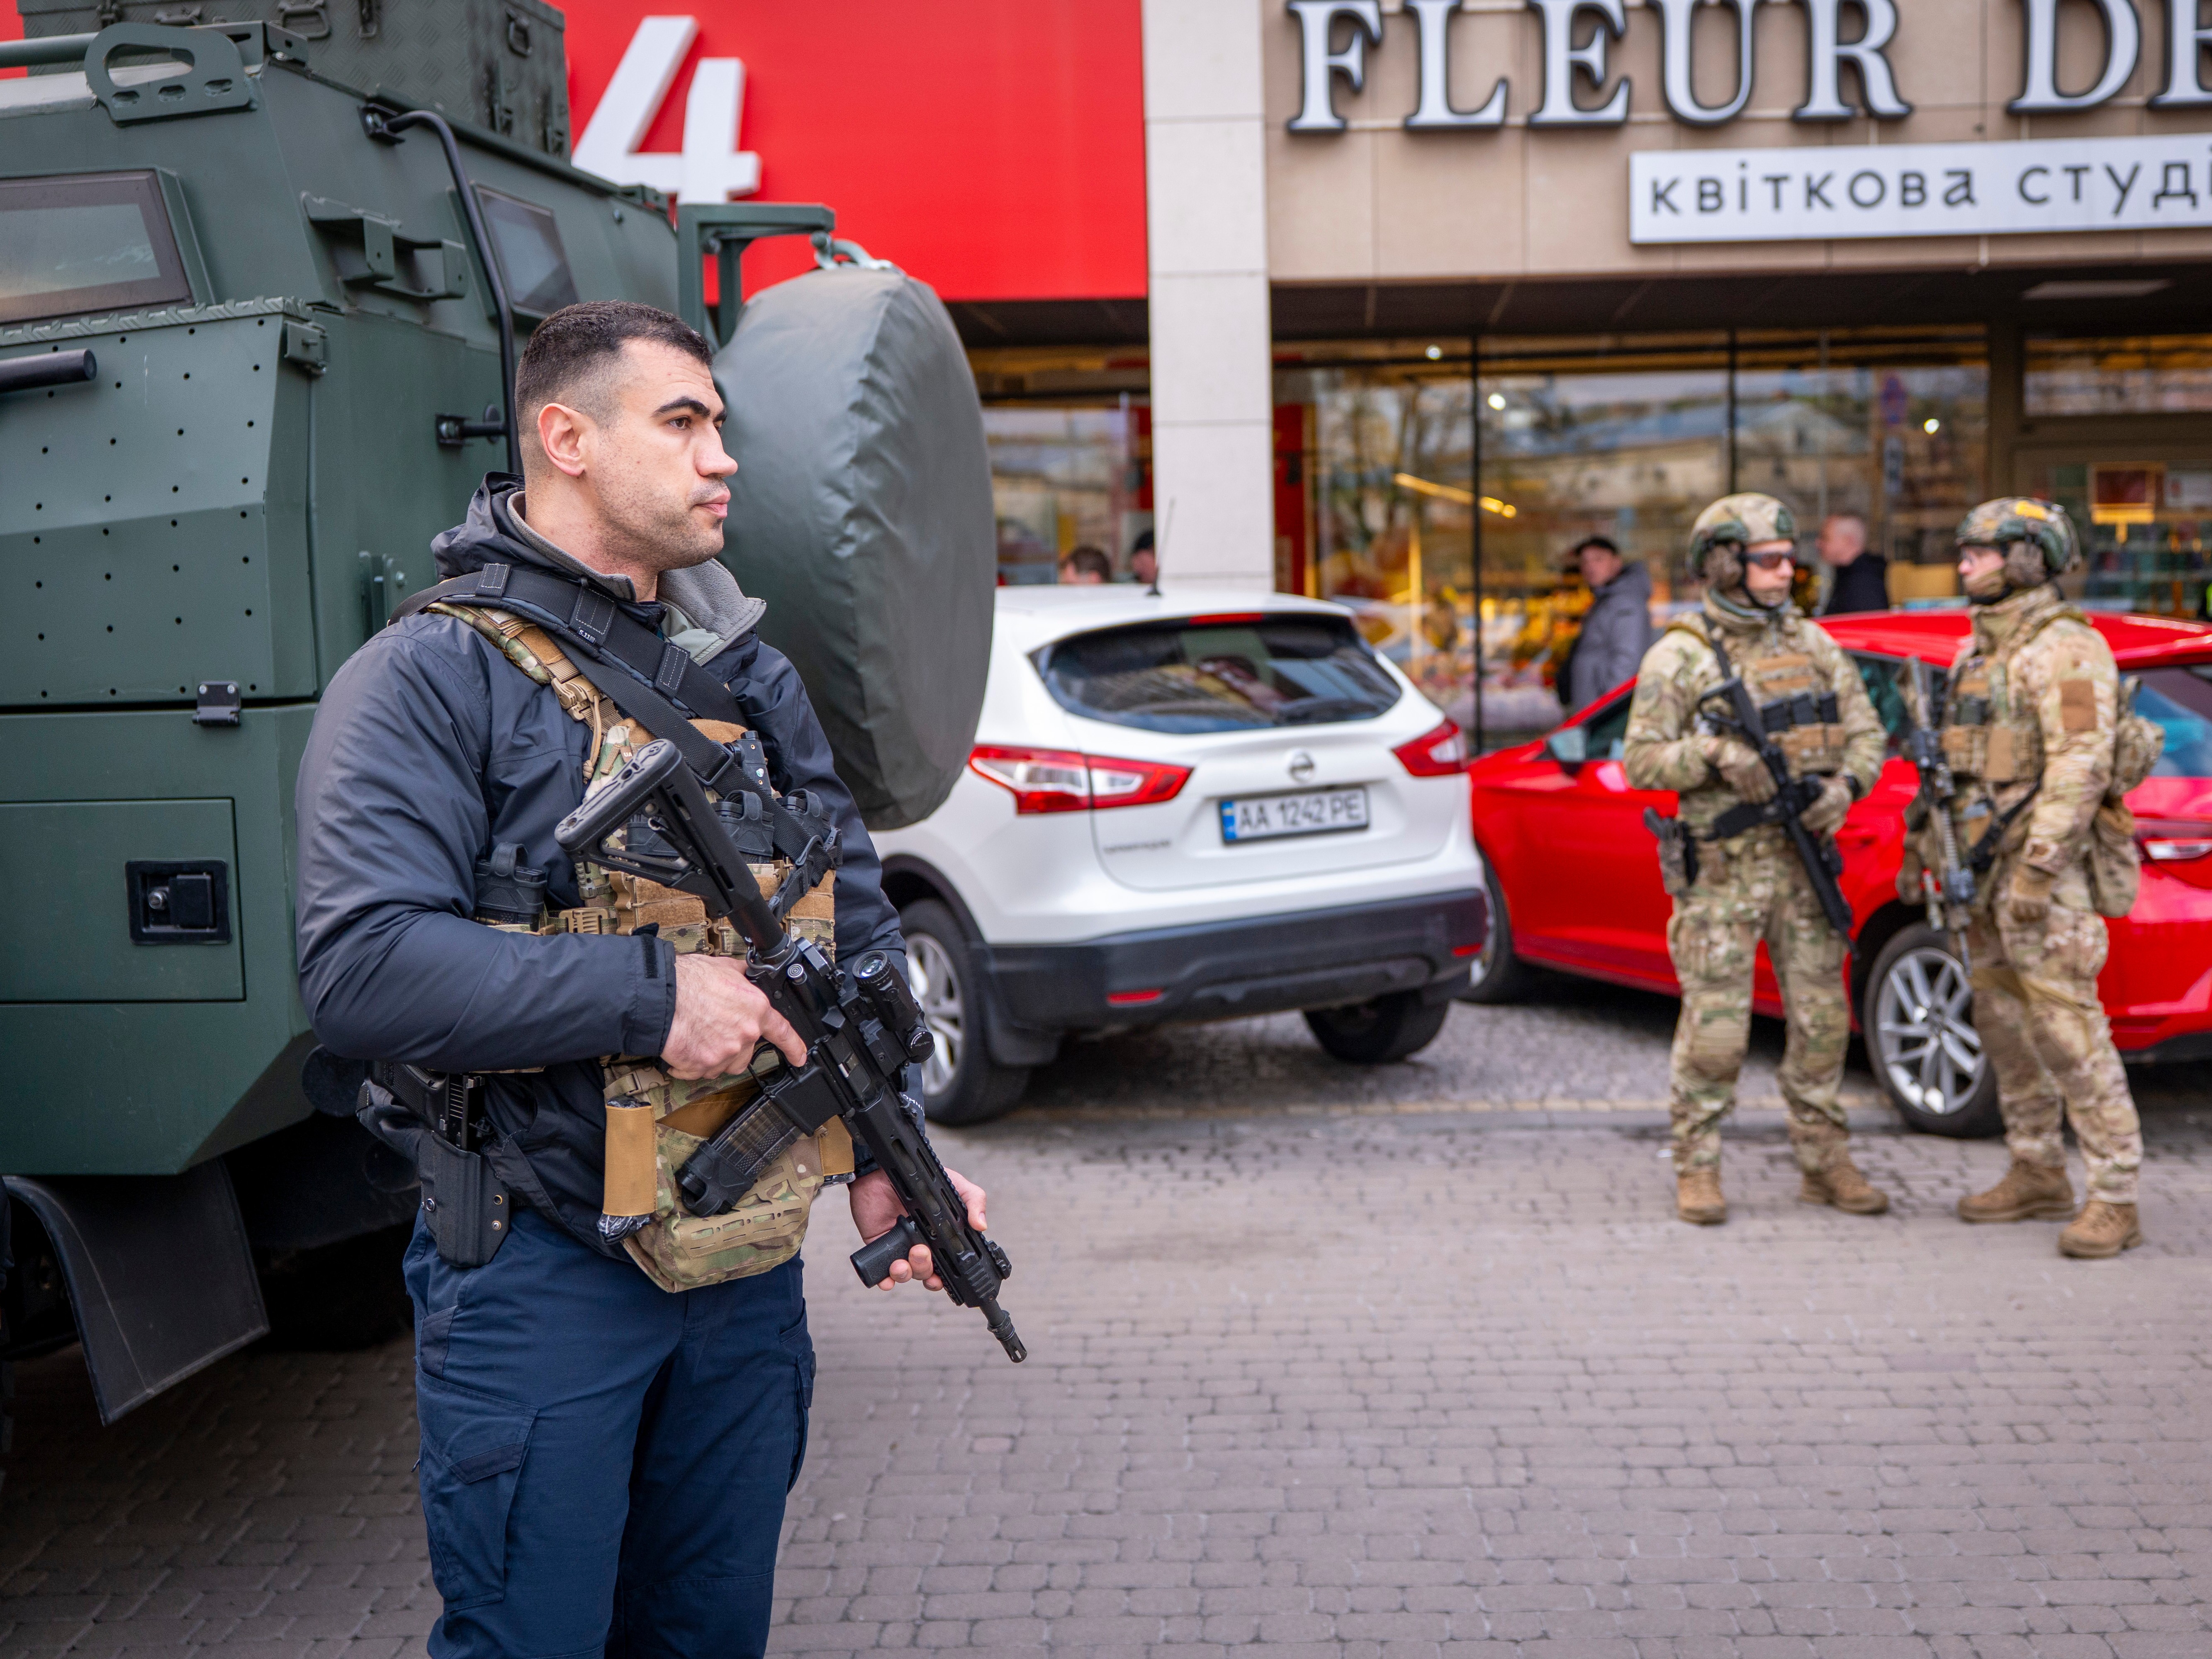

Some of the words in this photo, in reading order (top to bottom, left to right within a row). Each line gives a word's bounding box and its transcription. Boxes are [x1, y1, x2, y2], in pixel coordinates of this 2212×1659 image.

[1287, 0, 1911, 131] FLEUR
[571, 15, 762, 204] 4
[1651, 160, 1976, 215] квіткова
[579, 630, 590, 640] 5.11
[1240, 805, 1271, 830] AA
[903, 1094, 925, 1116] OMNI
